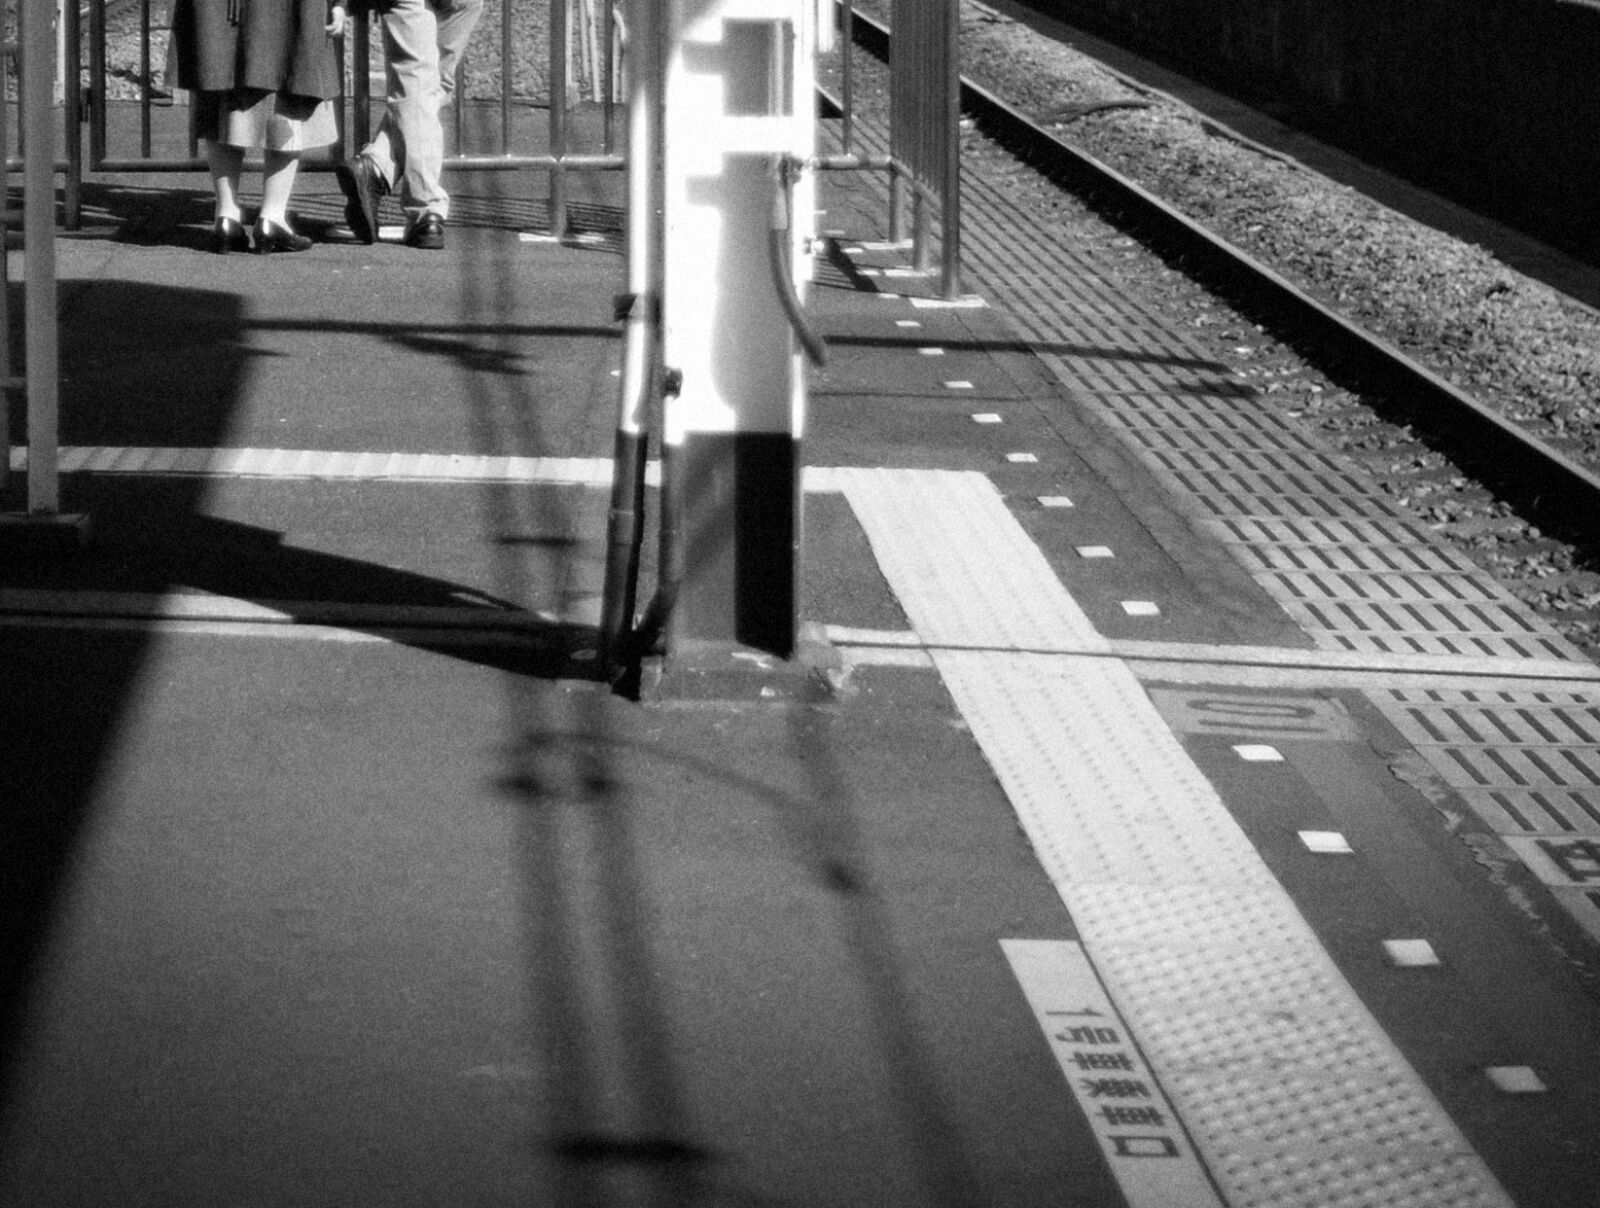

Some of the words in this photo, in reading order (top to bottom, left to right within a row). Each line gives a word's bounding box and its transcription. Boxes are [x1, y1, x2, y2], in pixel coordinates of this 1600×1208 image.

[1045, 1007, 1181, 1158] 1号車乗車口
